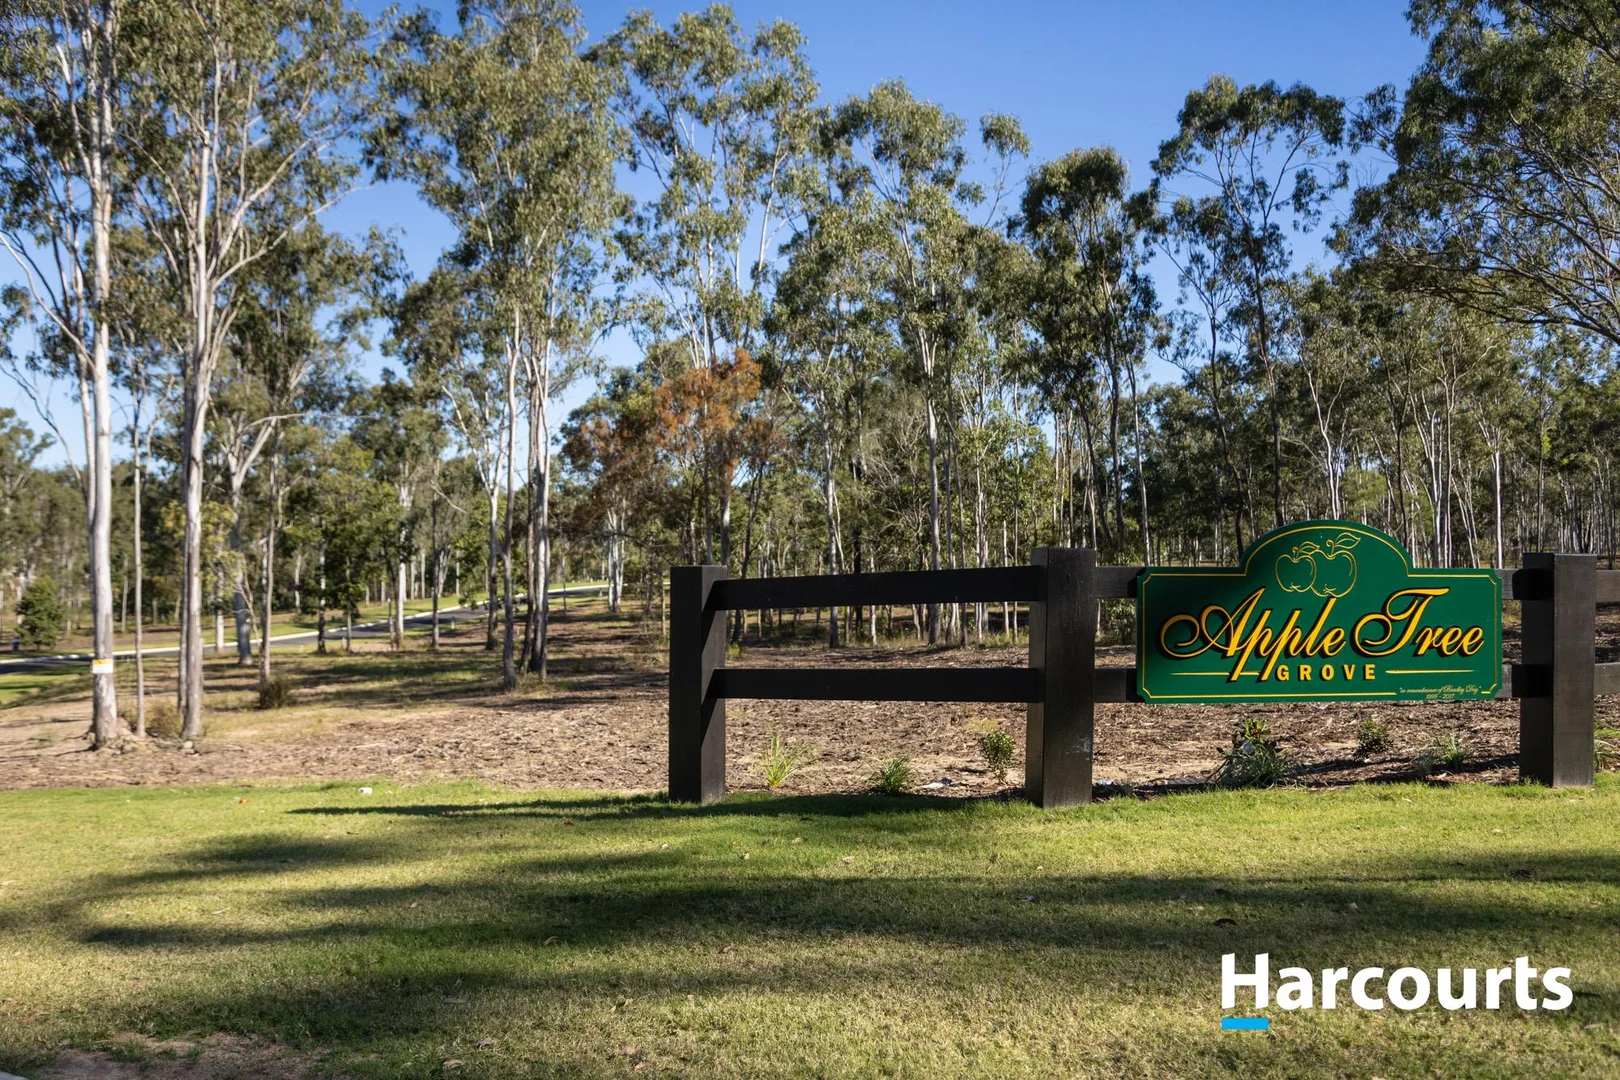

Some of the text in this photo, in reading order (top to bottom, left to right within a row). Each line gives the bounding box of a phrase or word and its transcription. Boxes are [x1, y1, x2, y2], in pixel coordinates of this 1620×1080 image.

[1160, 587, 1485, 681] Apple Tree
[1277, 664, 1377, 681] GROVE
